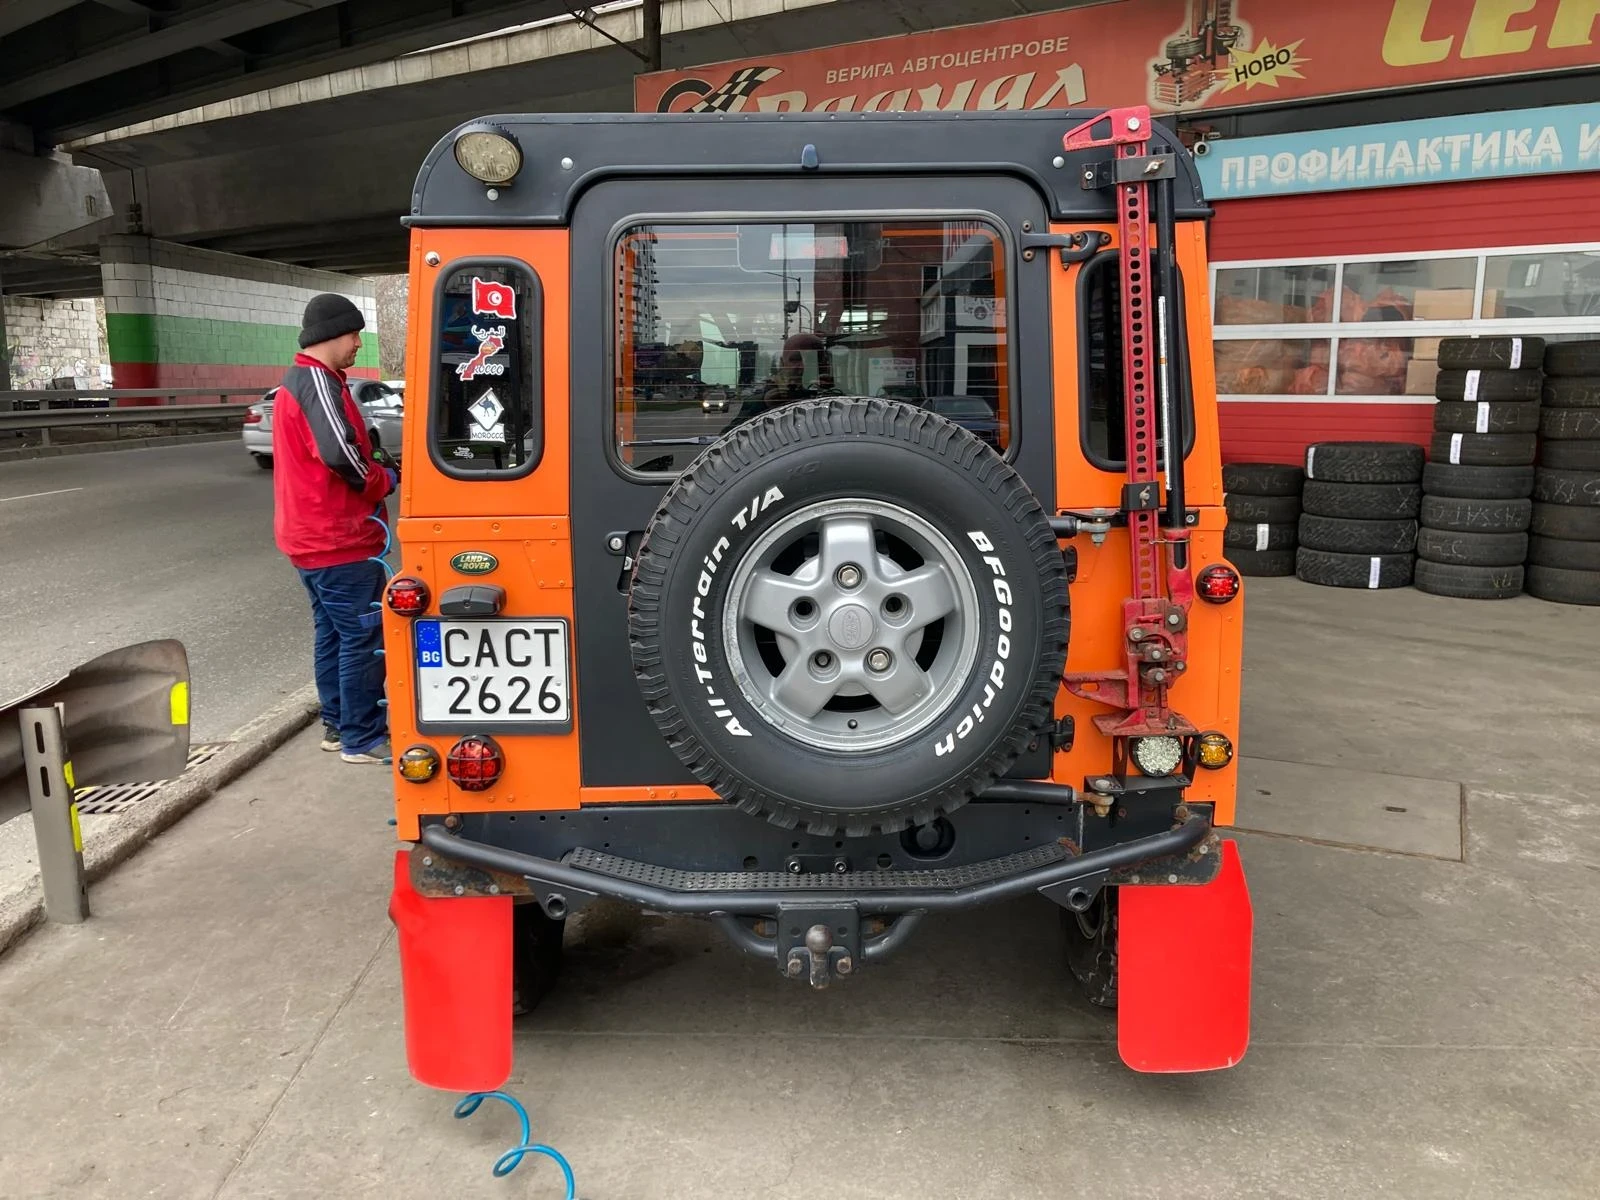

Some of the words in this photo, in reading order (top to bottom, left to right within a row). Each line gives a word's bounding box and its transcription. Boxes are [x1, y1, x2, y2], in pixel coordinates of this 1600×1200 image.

[1381, 0, 1600, 67] СЕ
[825, 64, 895, 85] ВЕРИГА
[901, 36, 1070, 74] АВТОЦЕНТРОВЕ
[1233, 47, 1292, 83] НОВО
[1220, 125, 1564, 188] ПРОФИЛАКТИКА
[456, 363, 504, 375] MROCCO
[471, 432, 504, 440] MOROCCO
[460, 555, 483, 563] LAND
[462, 562, 491, 570] ROVER
[691, 536, 753, 737] All-Terrain
[731, 486, 785, 530] T/A
[421, 650, 441, 663] BG
[444, 628, 560, 667] CACT
[934, 531, 1013, 757] BFGoodrich
[447, 675, 562, 715] 2626
